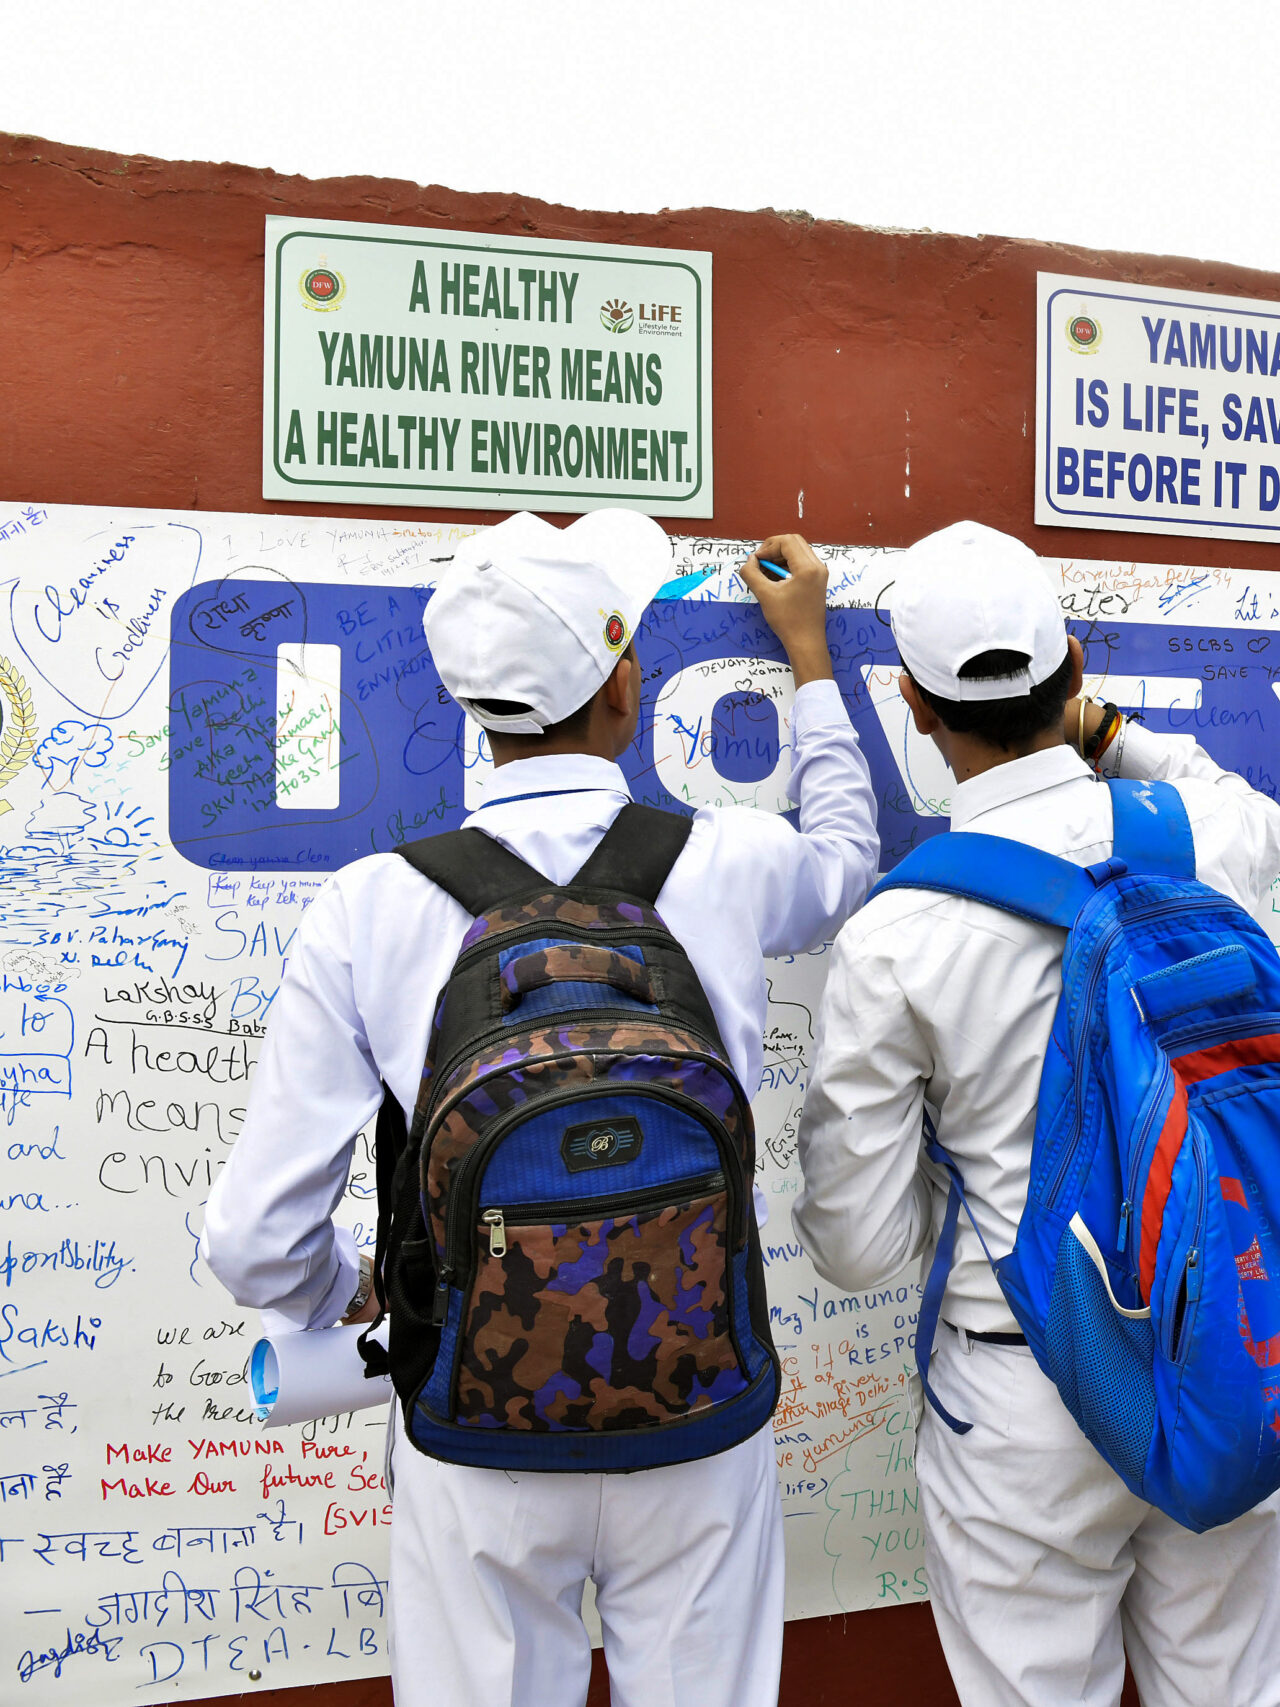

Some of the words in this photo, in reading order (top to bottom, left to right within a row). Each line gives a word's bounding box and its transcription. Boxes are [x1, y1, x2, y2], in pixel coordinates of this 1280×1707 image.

[313, 280, 332, 290] DFW
[409, 259, 431, 314] A
[441, 261, 579, 324] HEALTHY
[638, 303, 682, 324] LiFE
[638, 323, 667, 332] Lifestyle
[669, 324, 679, 332] for
[638, 329, 683, 337] Environment
[318, 330, 451, 394] YAMUNA
[461, 341, 552, 398] RIVER
[561, 348, 663, 406] MEANS
[1075, 378, 1109, 428] IS
[1123, 383, 1209, 450] LIFE,
[284, 409, 306, 464] A
[317, 411, 461, 472] HEALTHY
[471, 420, 692, 484] ENVIRONMENT.
[1057, 446, 1200, 506] BEFORE
[1214, 461, 1247, 509] IT
[94, 598, 119, 620] is
[336, 601, 376, 636] BE
[388, 596, 399, 617] A
[1168, 637, 1234, 653] SSCBS
[1201, 665, 1248, 680] SAVE
[276, 642, 342, 811] I
[85, 1028, 112, 1063] A
[8, 1126, 66, 1160] and
[856, 1322, 869, 1339] is
[152, 1402, 182, 1423] the
[106, 1442, 172, 1465] Make
[188, 1439, 284, 1459] YAMUNA
[302, 1441, 368, 1463] Pure,
[101, 1478, 176, 1500] Make
[187, 1472, 237, 1495] Our
[259, 1464, 336, 1499] future
